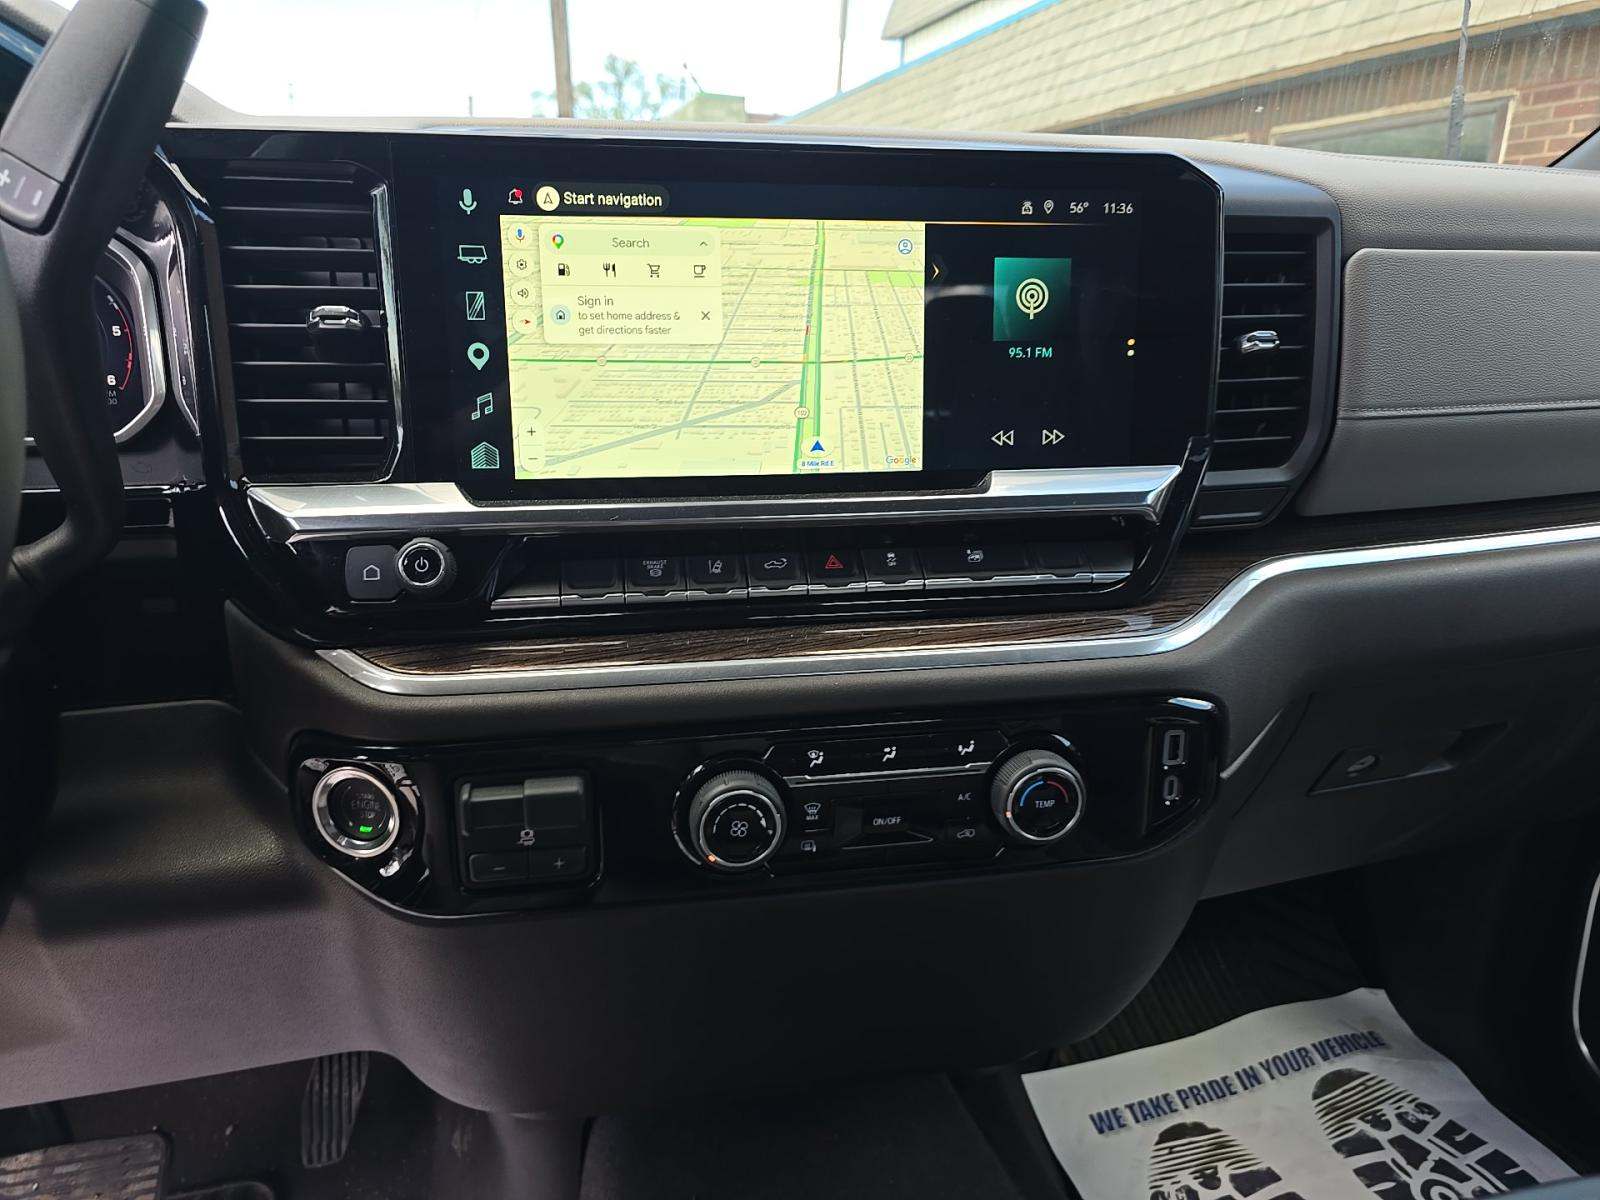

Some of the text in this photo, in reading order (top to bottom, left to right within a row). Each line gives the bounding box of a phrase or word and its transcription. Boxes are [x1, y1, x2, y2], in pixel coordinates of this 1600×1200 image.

[563, 191, 663, 209] Start navigation
[1069, 202, 1134, 214] 56° 11:36
[611, 236, 650, 250] Search
[577, 295, 614, 309] Sign in
[578, 311, 681, 321] to set home address &
[112, 326, 121, 336] 5
[578, 325, 672, 337] get directions faster
[1008, 347, 1053, 359] 95.1 FM
[106, 375, 116, 386] 6
[886, 456, 916, 465] Google
[957, 792, 972, 801] A/C
[351, 799, 381, 810] ENGINE
[1035, 799, 1056, 809] TEMP
[872, 816, 902, 826] ON/OFF
[1089, 1029, 1386, 1135] WE TAKE PRIDE IN YOUR VEHICLE
